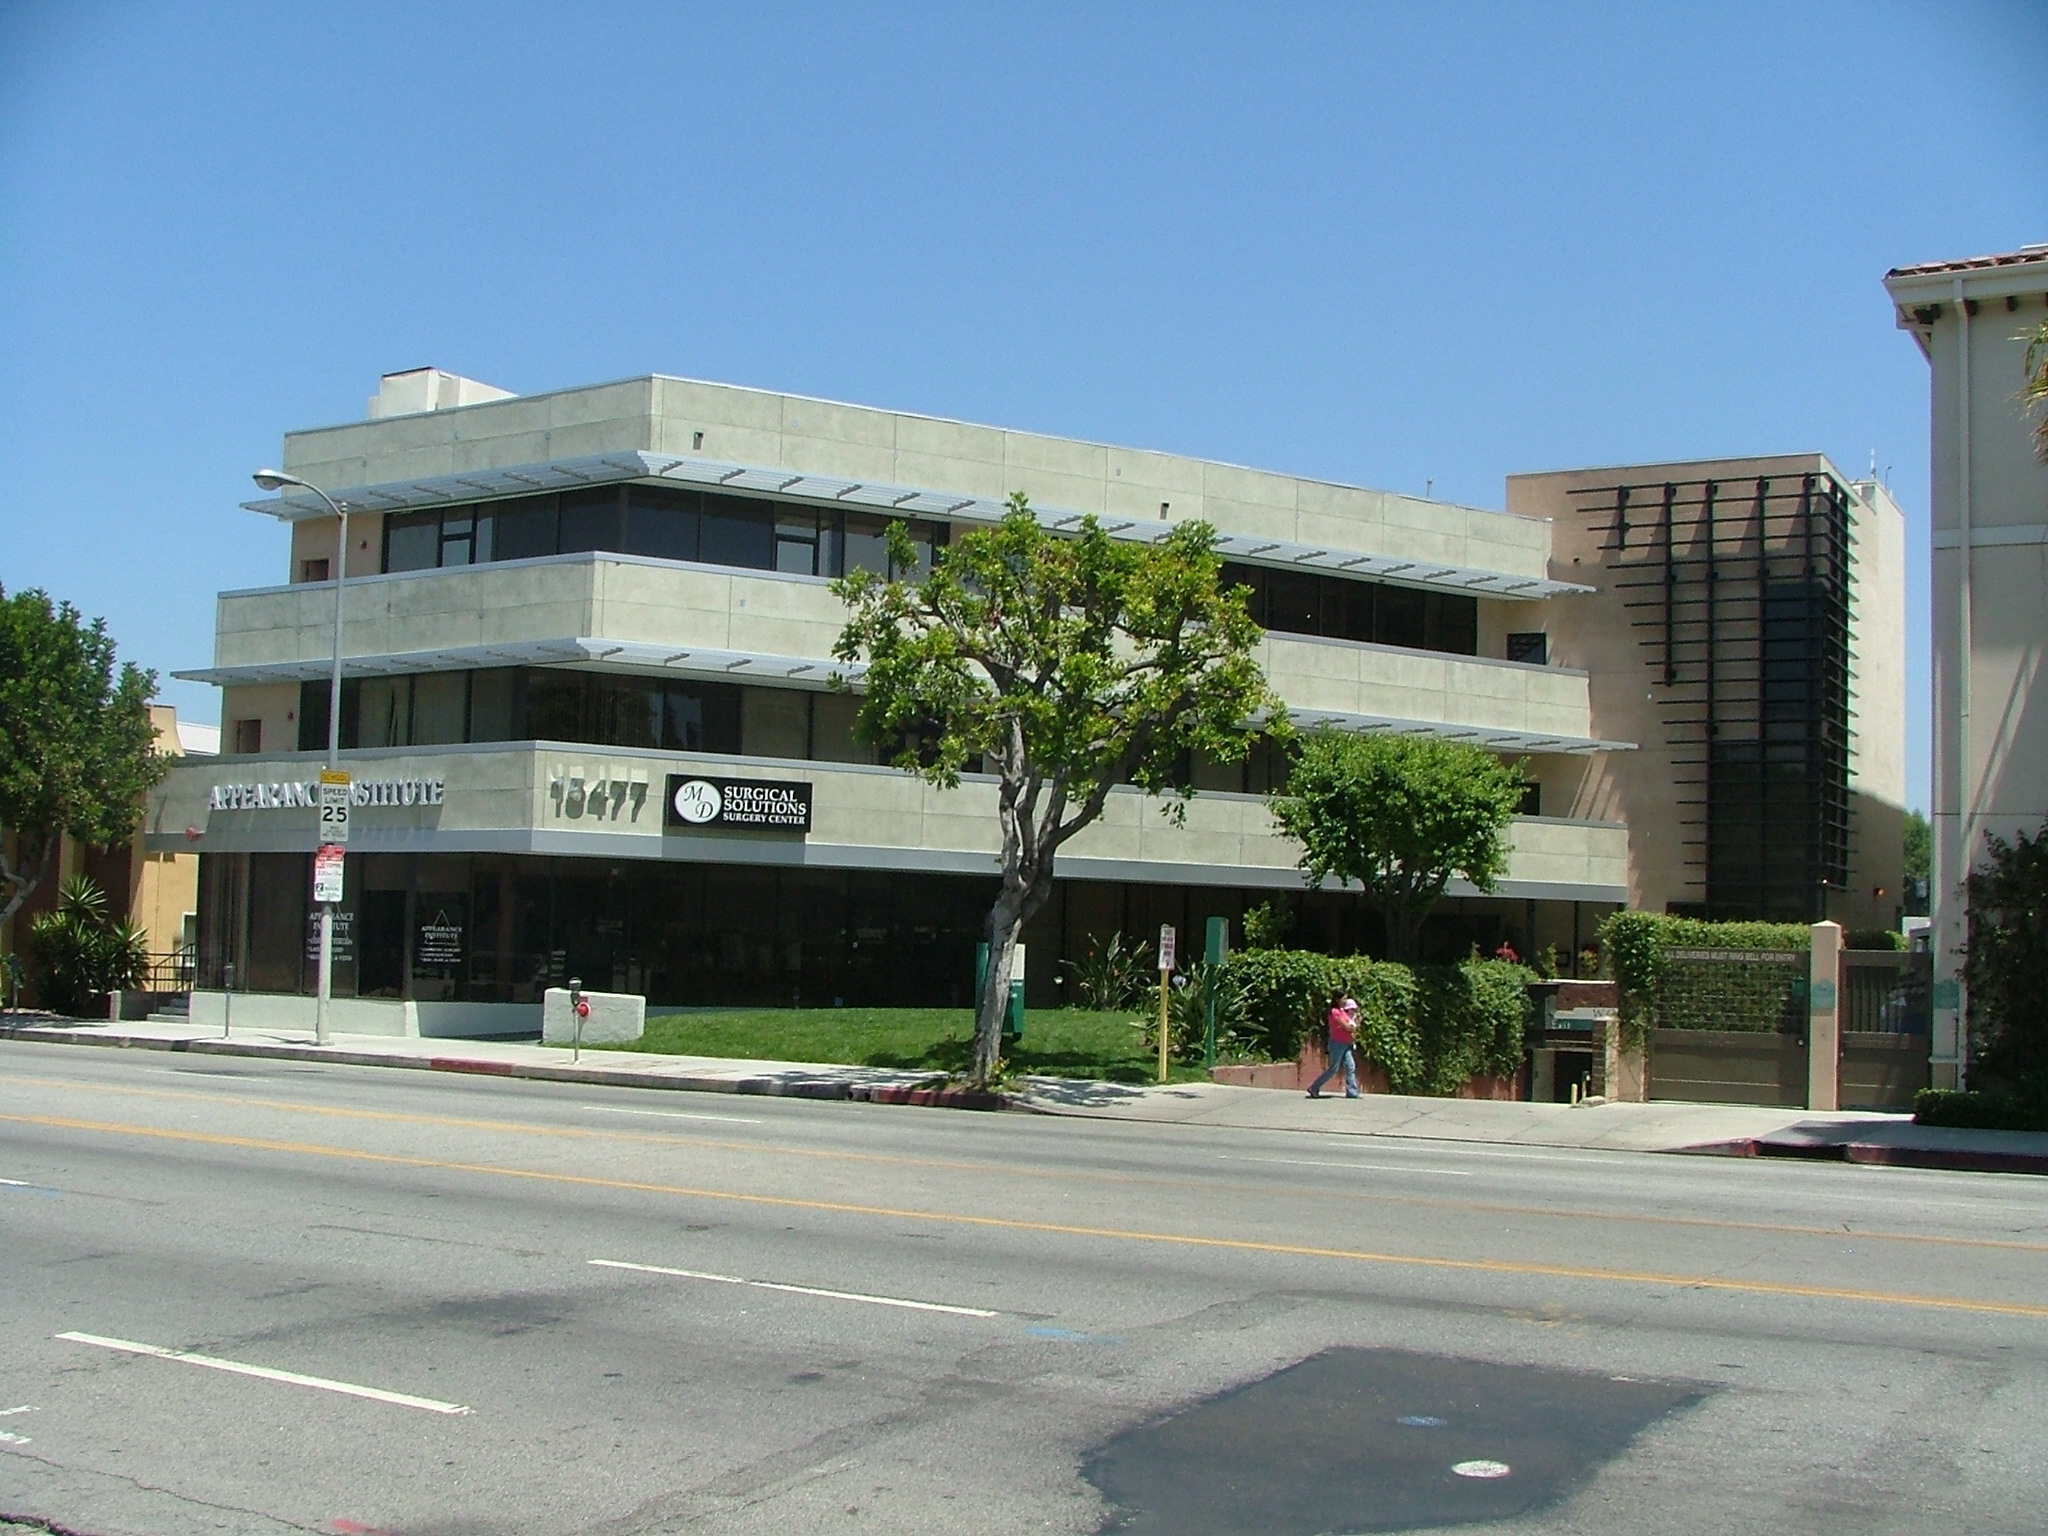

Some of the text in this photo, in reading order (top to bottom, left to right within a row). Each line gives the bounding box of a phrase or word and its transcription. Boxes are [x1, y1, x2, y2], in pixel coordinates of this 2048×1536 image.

[208, 778, 444, 810] APPEARANC NSTITUTE
[323, 787, 347, 796] SPEED
[724, 786, 797, 802] SURGICAL
[322, 806, 347, 823] 25
[723, 799, 807, 815] SOLUTIONS
[723, 812, 805, 825] SURGERY CENTER
[1745, 952, 1760, 961] BELL
[1761, 952, 1774, 961] FOR
